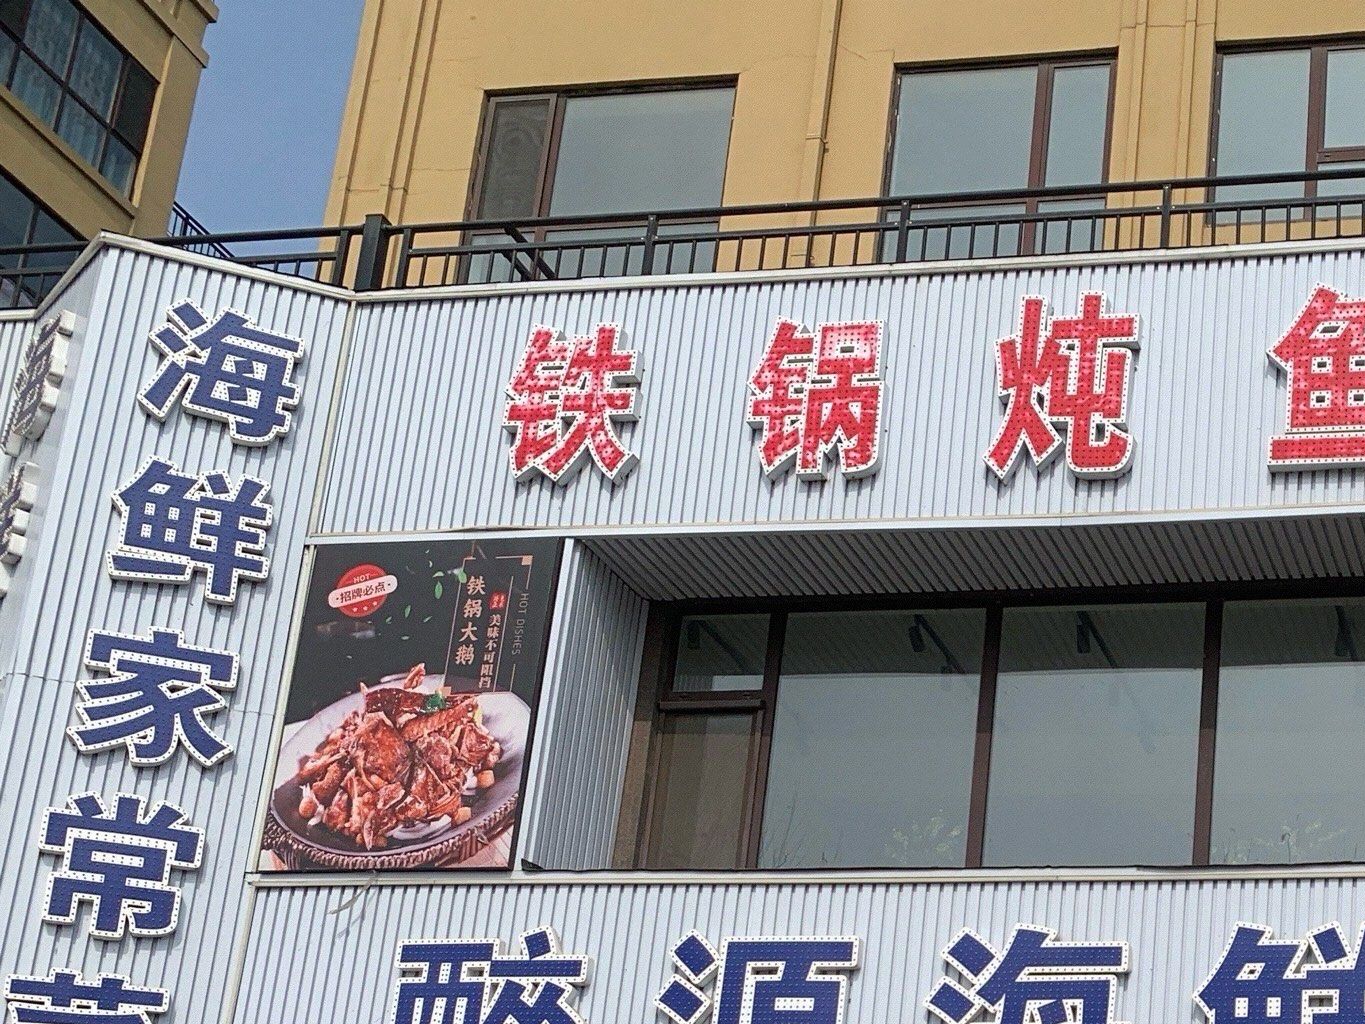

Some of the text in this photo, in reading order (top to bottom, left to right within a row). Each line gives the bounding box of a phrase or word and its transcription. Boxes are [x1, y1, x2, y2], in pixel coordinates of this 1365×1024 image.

[339, 582, 386, 604] 招牌必点
[352, 574, 371, 583] HOT
[455, 575, 486, 666] 铁锅大鹅
[478, 614, 501, 689] 美味不可阻挡
[511, 592, 530, 655] HOT DISHES
